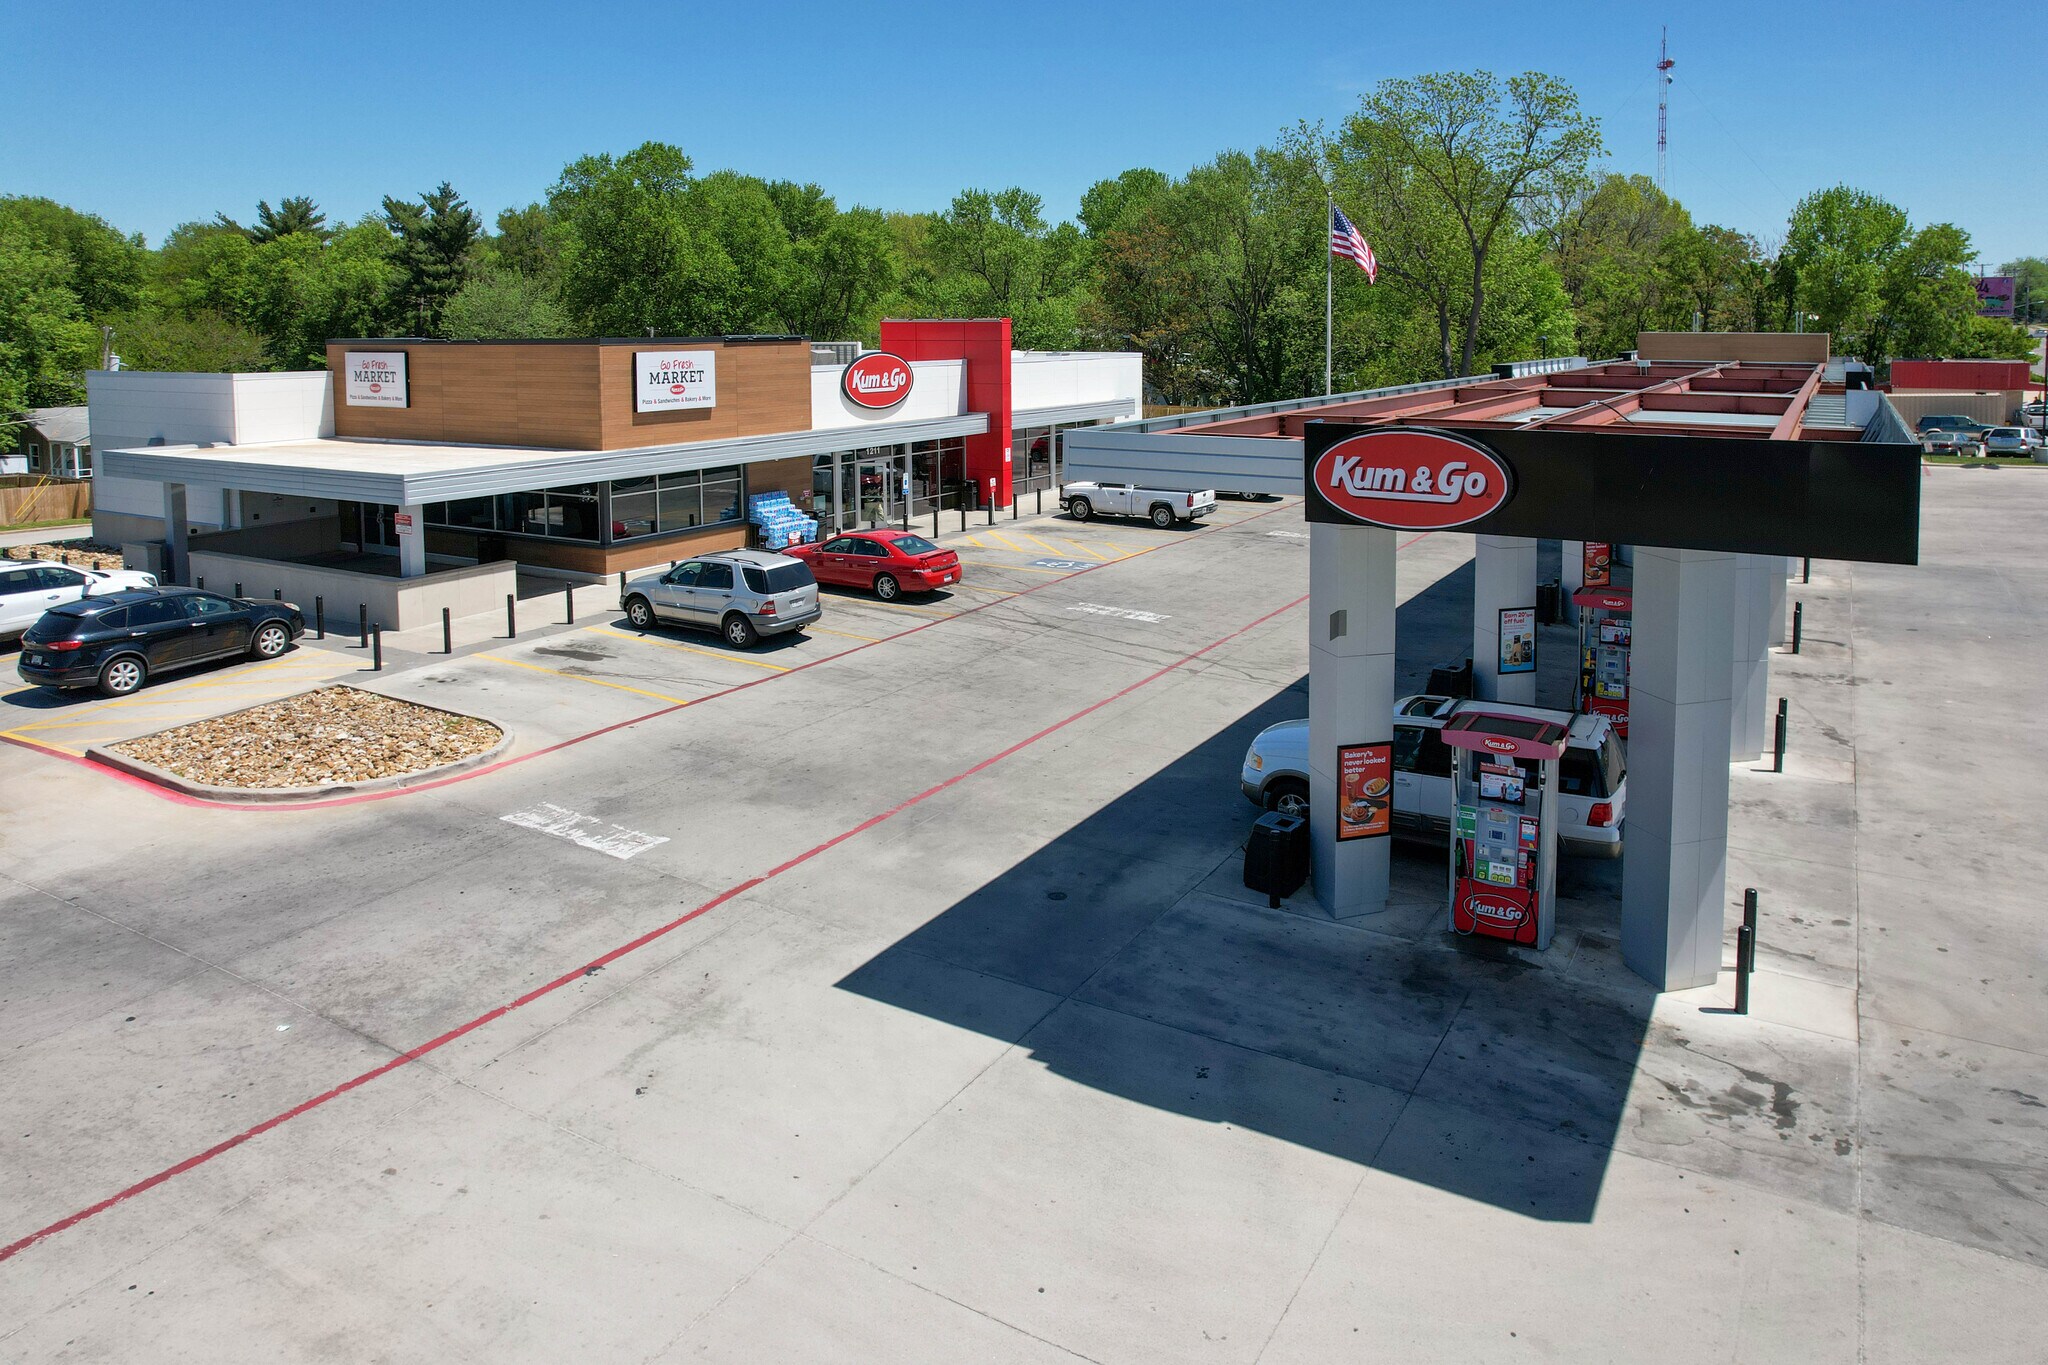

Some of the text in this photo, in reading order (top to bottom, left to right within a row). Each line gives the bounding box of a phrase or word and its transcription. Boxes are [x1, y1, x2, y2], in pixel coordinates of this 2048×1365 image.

[362, 360, 388, 370] Go Fresh
[661, 360, 694, 370] Go Fresh
[354, 370, 397, 383] MARKET
[649, 370, 704, 384] MARKET
[852, 368, 906, 391] Kum & Go
[866, 447, 880, 455] 1211
[1330, 456, 1488, 500] Kum & Go
[1618, 714, 1628, 723] Go
[1485, 740, 1500, 748] Kum
[1470, 900, 1522, 920] Kum & Go
